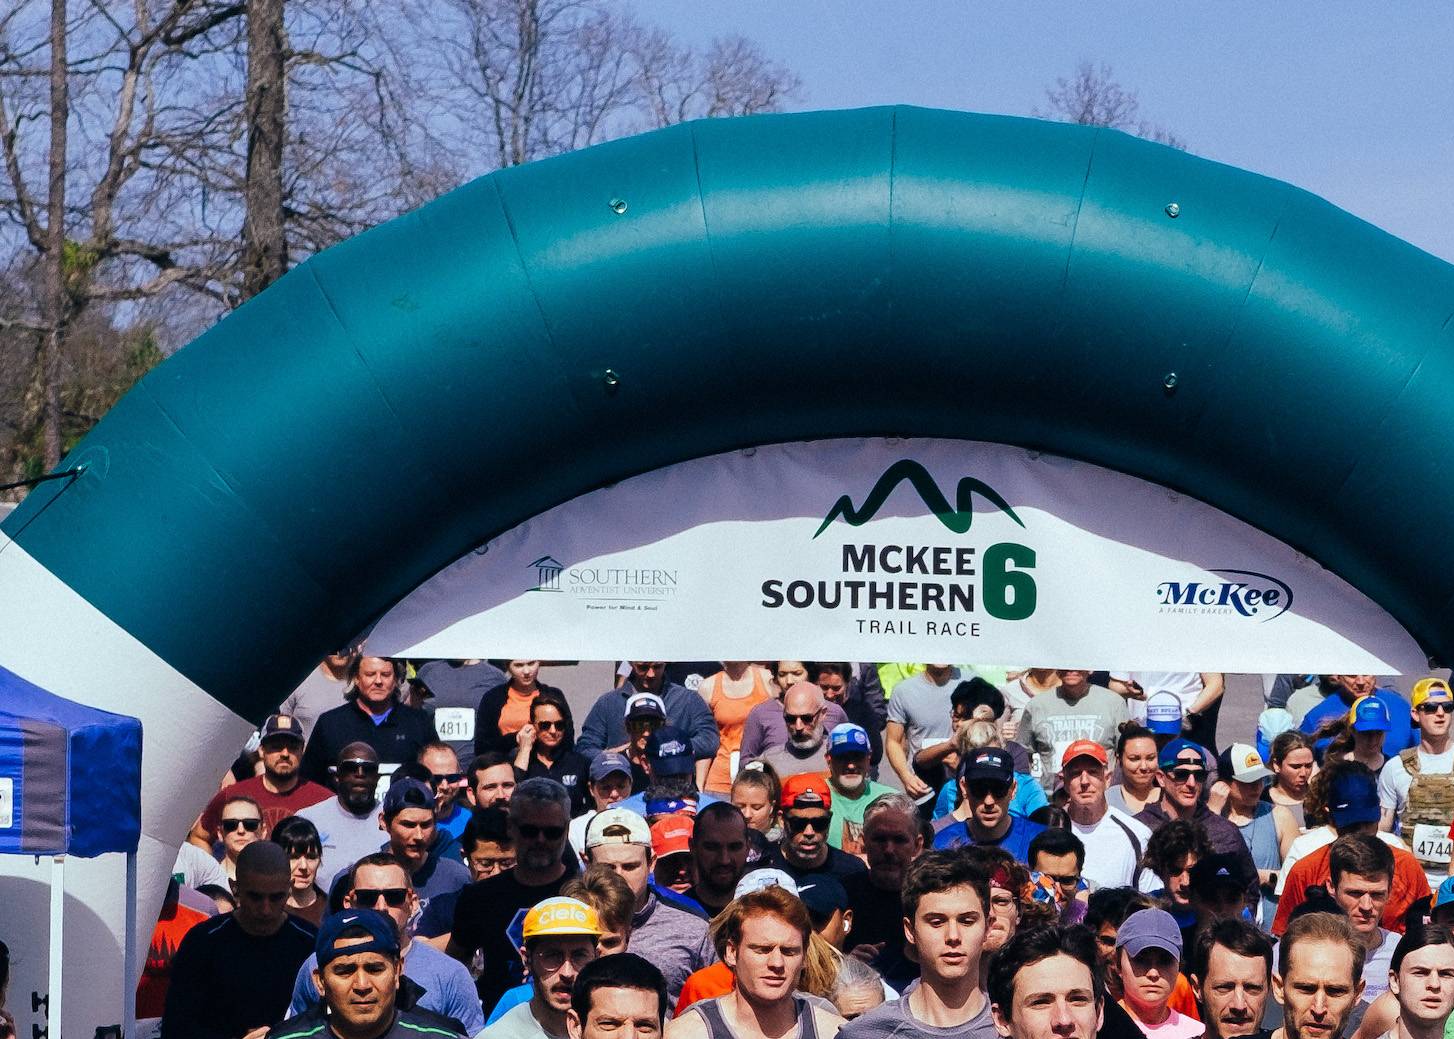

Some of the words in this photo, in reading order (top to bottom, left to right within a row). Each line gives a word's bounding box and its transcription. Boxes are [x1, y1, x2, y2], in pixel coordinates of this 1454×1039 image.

[842, 544, 976, 575] MCKEE
[569, 568, 678, 585] SOUTHERN
[982, 542, 1037, 620] 6
[569, 586, 619, 594] ADVENTIST
[623, 587, 677, 595] UNIVERSITY
[761, 579, 975, 612] SOUTHERN
[1157, 582, 1280, 616] McKee
[856, 619, 917, 635] TRAIL
[926, 622, 981, 637] RACE
[440, 722, 468, 735] 4811
[1418, 841, 1452, 857] 4744
